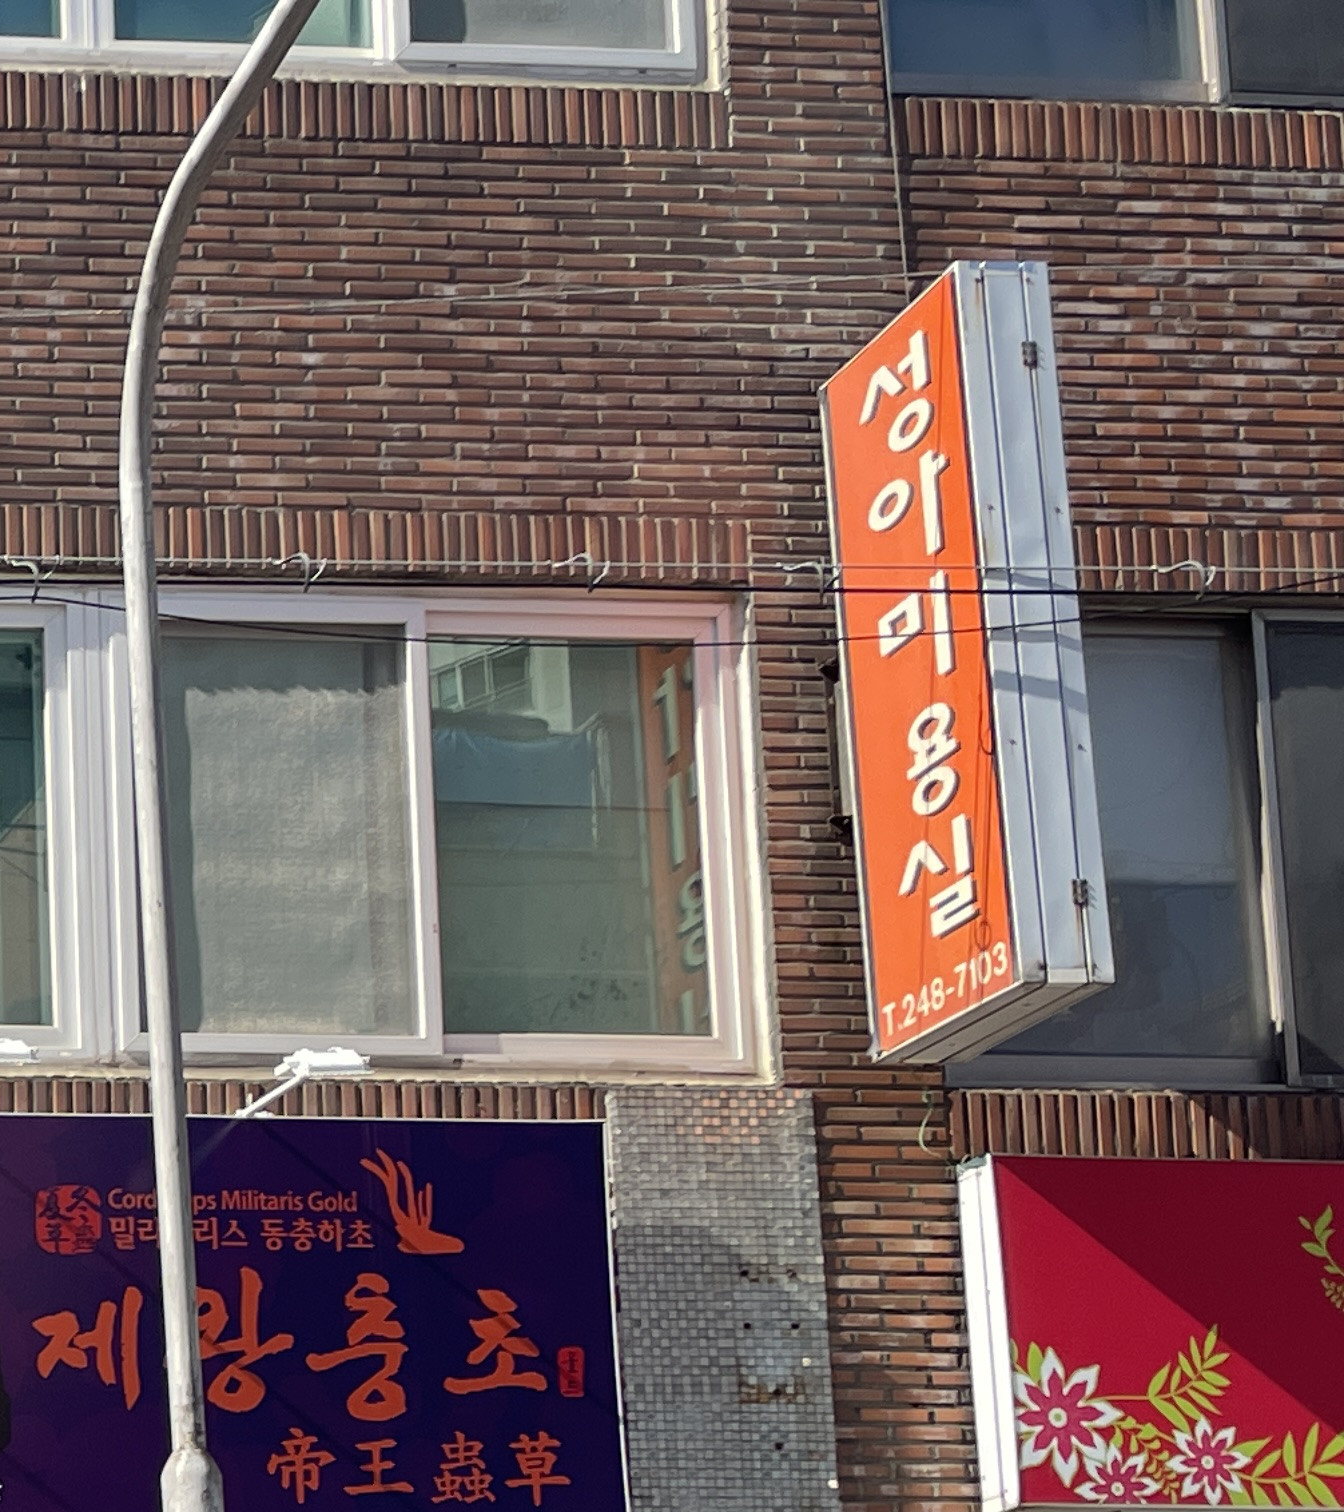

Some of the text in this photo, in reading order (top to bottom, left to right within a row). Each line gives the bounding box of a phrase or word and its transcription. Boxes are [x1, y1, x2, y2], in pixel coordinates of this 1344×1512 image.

[858, 329, 979, 938] 성아미용실
[881, 943, 1010, 1037] T.248-7103
[107, 1187, 358, 1213] Cordps Militaris Gold
[108, 1216, 376, 1253] 밀리리스 동충하초
[266, 1427, 571, 1508] 帝王蟲草
